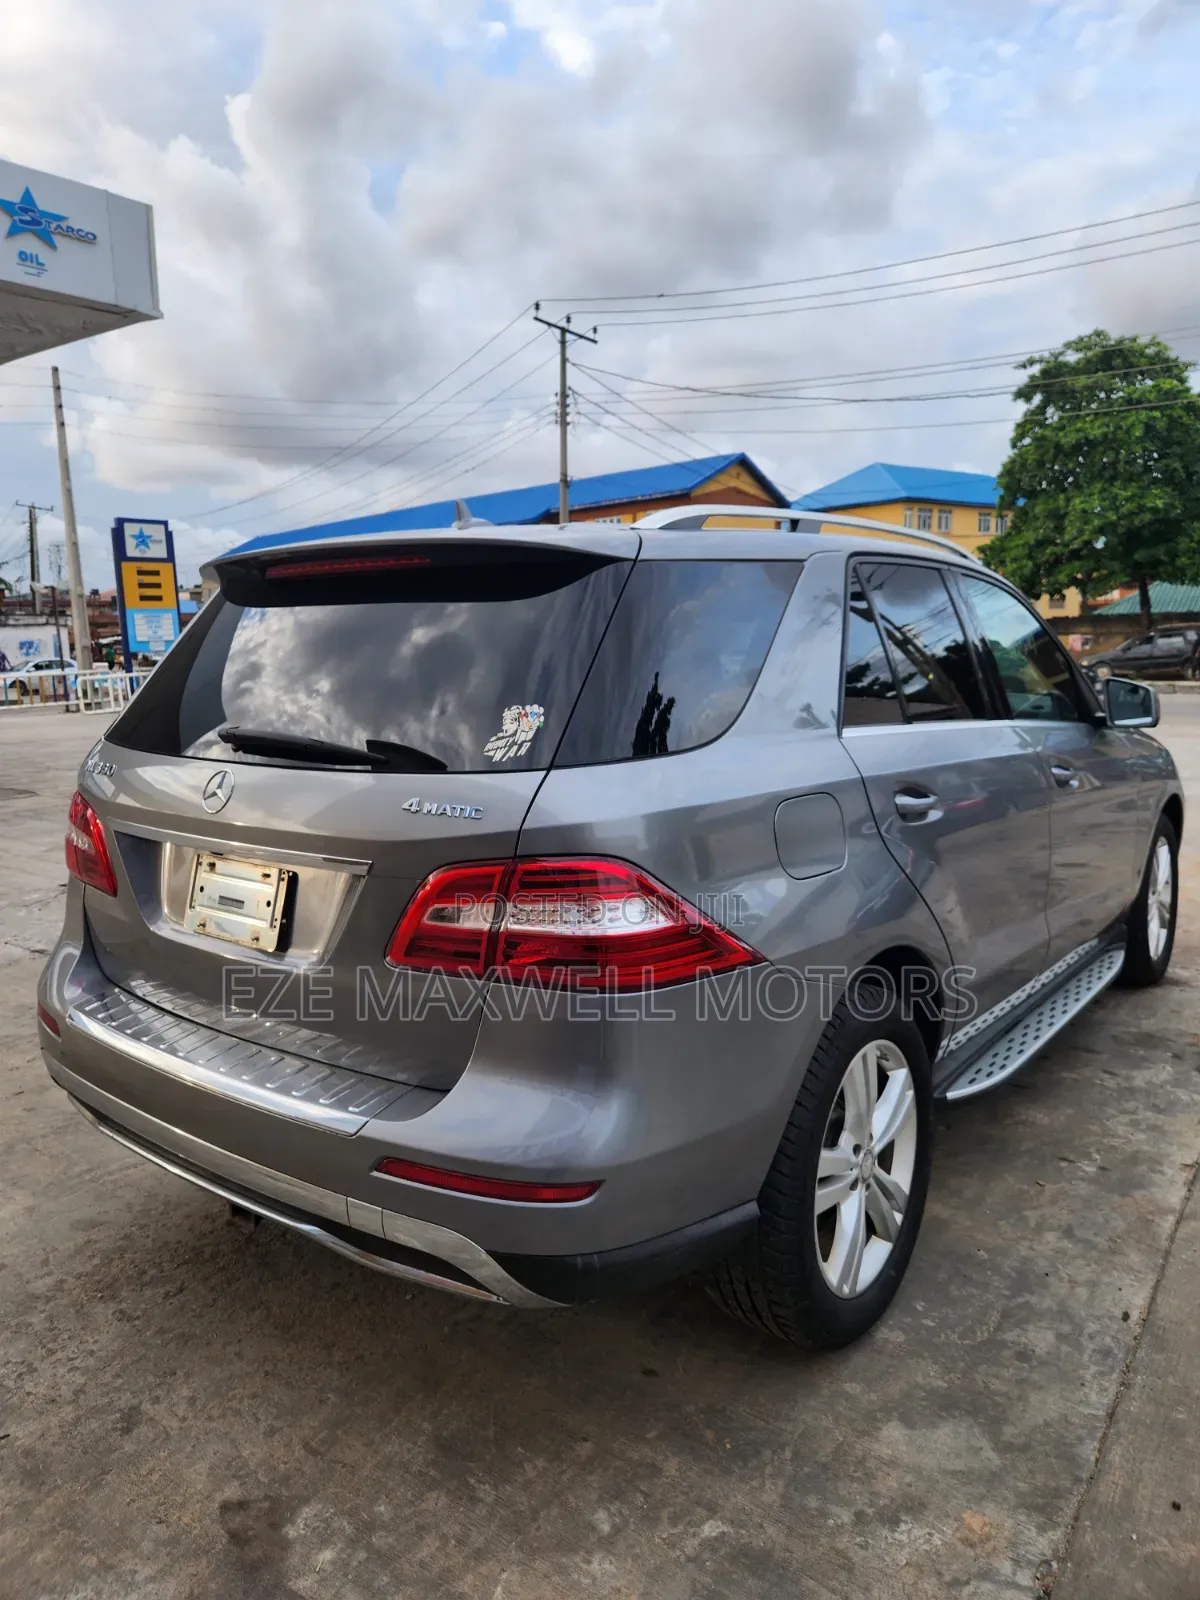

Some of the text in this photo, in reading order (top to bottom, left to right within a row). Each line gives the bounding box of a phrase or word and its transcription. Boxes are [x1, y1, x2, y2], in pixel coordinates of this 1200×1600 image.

[16, 204, 97, 241] STARCO
[18, 250, 46, 266] OIL
[492, 742, 531, 762] WAR
